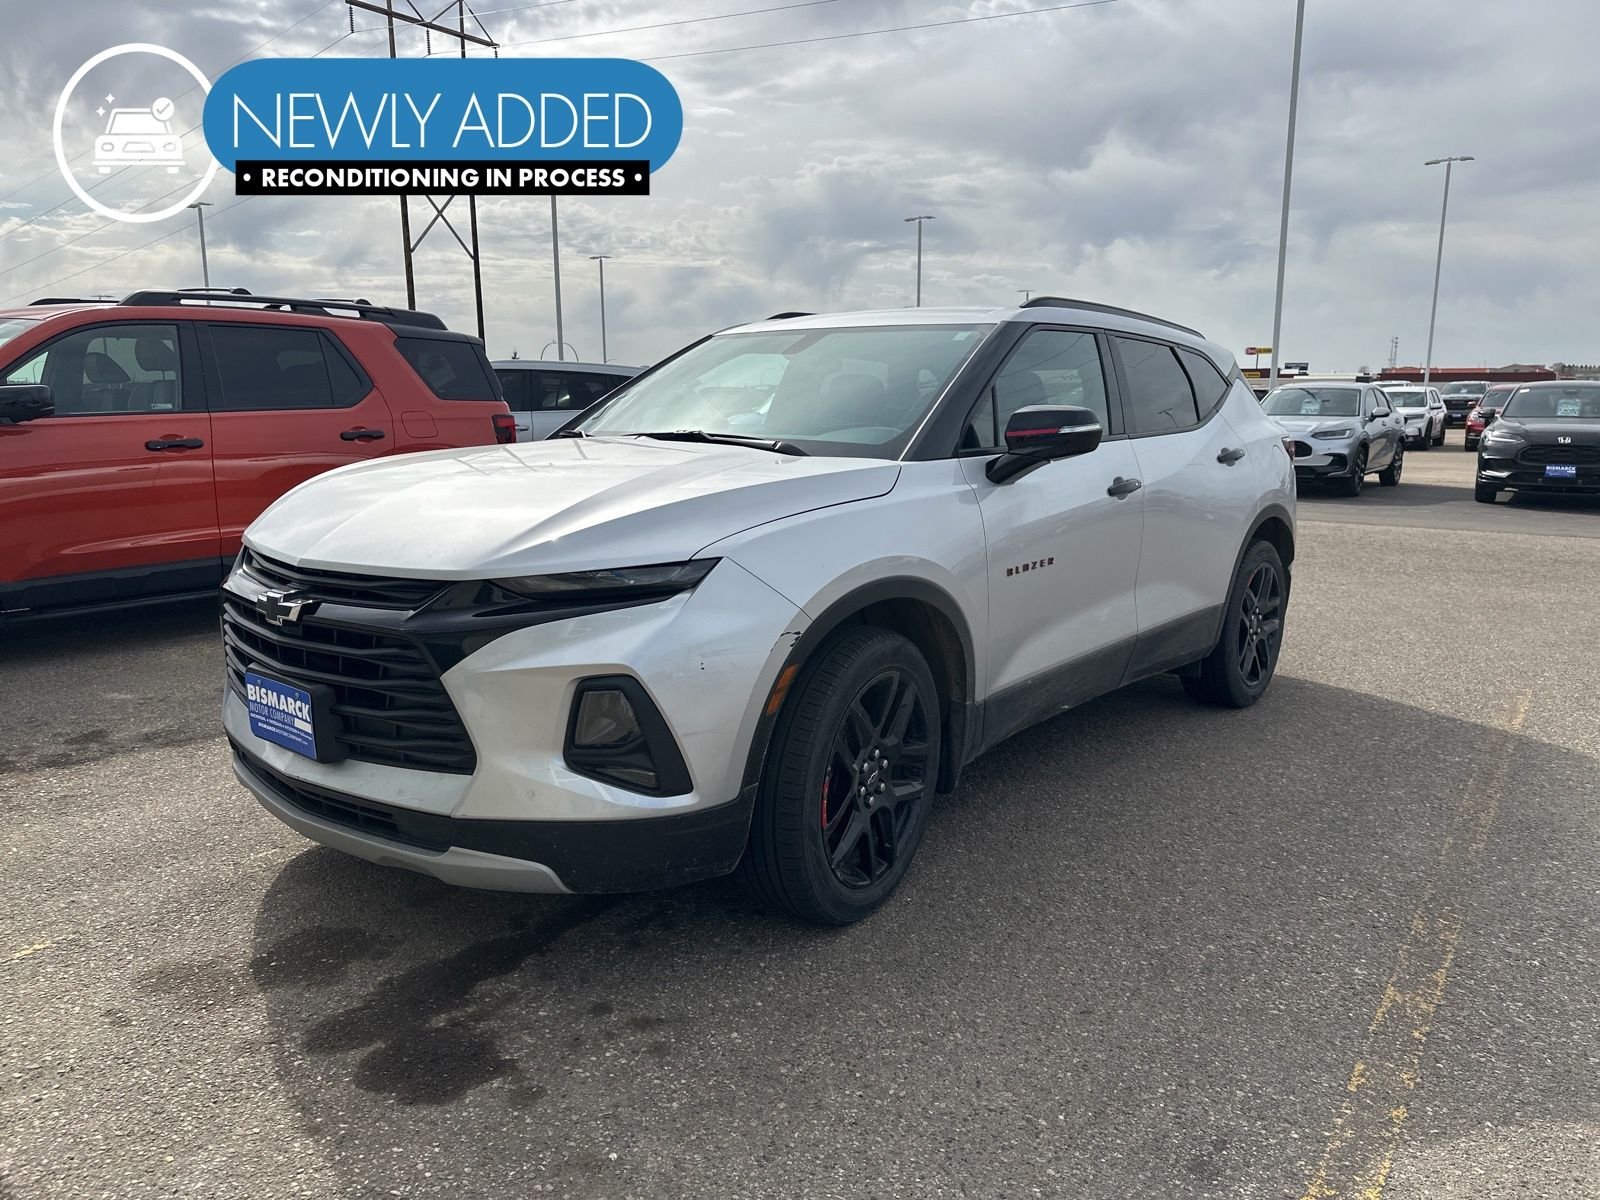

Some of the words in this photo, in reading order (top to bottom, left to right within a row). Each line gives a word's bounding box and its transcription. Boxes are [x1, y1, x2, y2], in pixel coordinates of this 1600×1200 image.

[1006, 557, 1054, 577] BLAZER
[247, 683, 311, 722] BISMARCK
[250, 701, 269, 717] MOTOR
[269, 708, 295, 727] COMPANY
